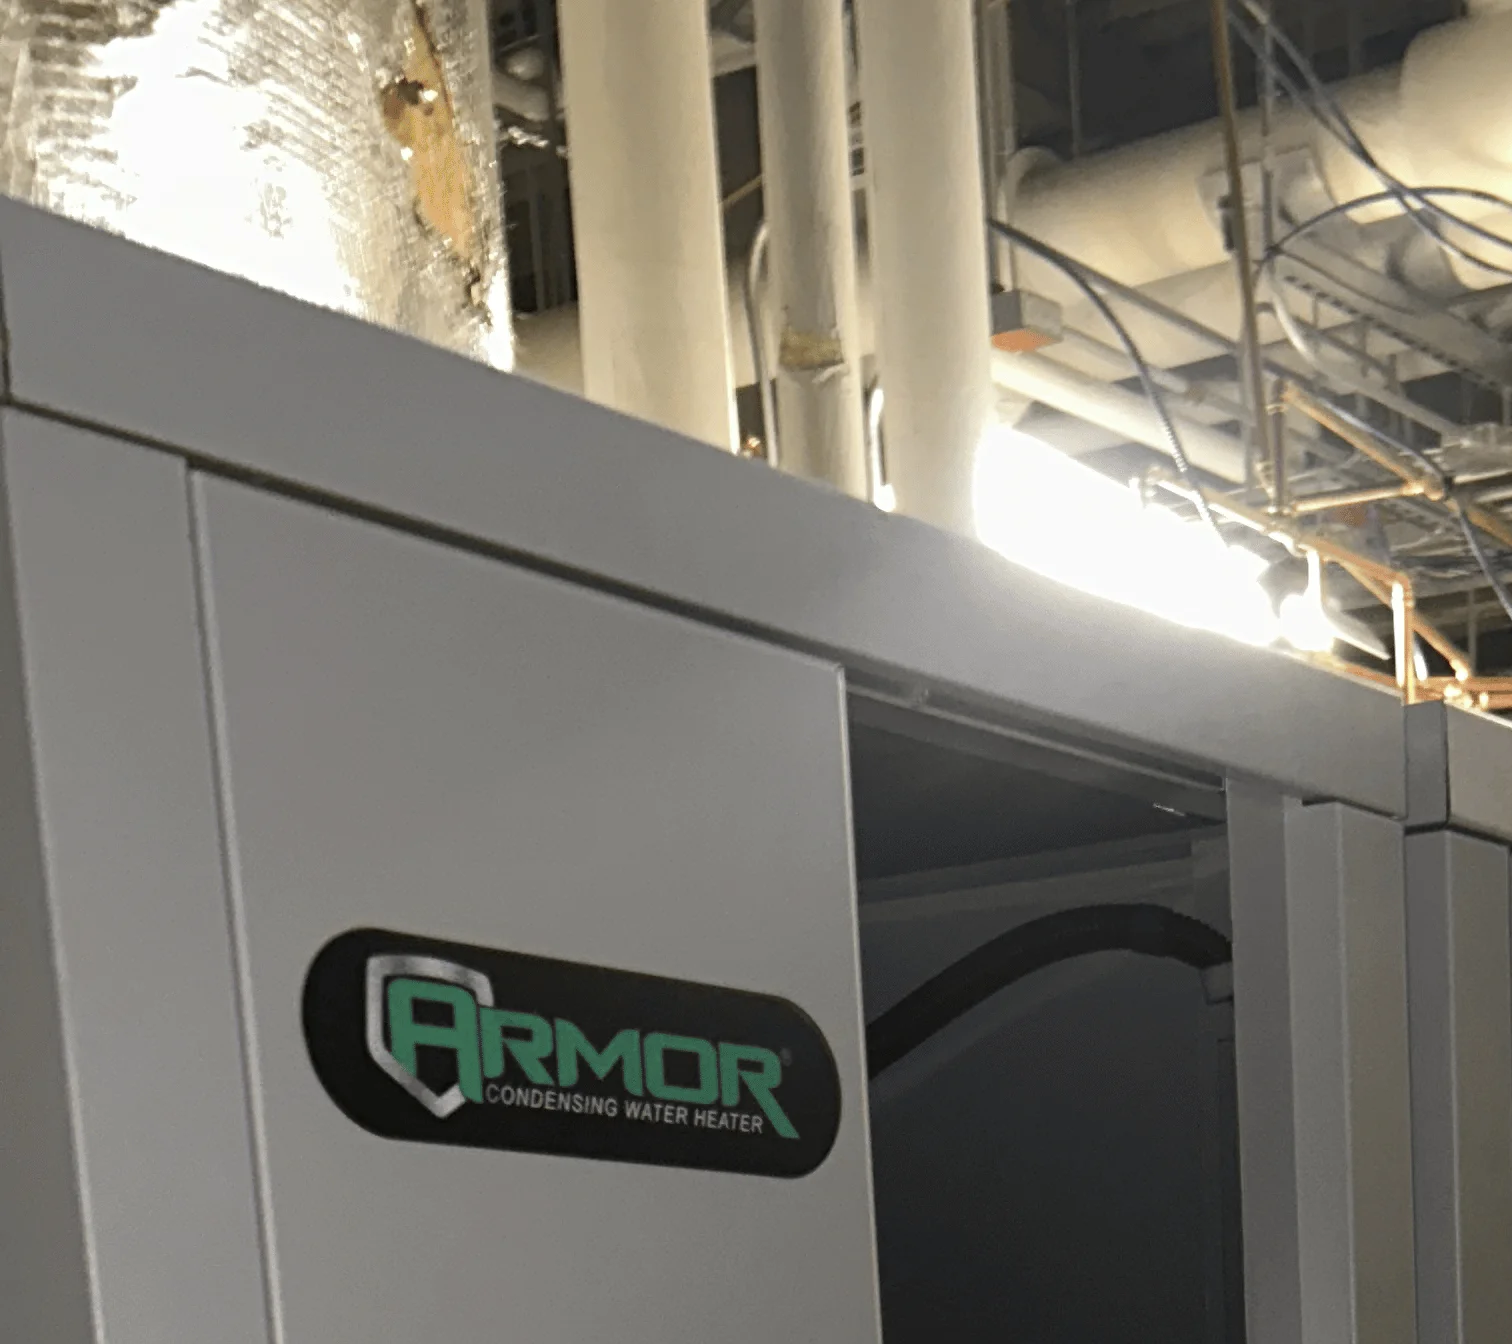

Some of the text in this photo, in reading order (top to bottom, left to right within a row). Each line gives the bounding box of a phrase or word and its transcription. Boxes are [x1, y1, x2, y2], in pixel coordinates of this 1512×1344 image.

[387, 978, 800, 1139] ARMOR
[484, 1082, 764, 1134] CONDENSING WATER HEATER
